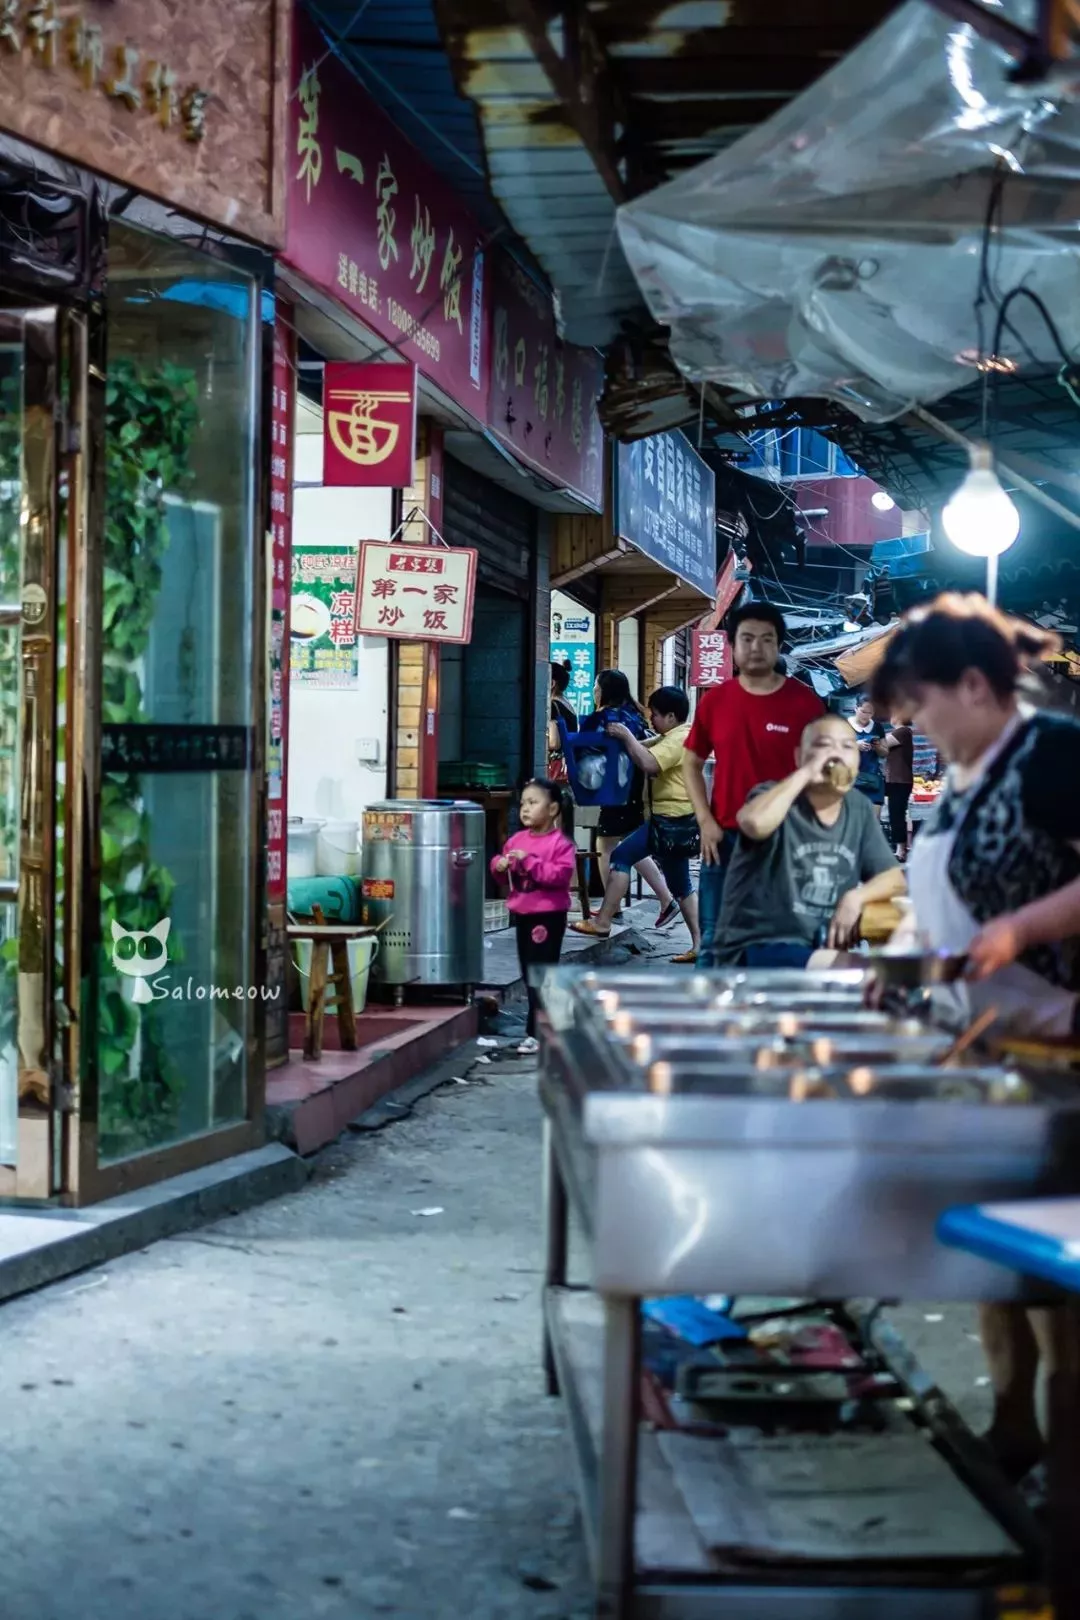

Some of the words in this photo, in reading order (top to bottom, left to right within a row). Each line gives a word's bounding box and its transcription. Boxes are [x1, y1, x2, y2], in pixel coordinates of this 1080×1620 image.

[371, 578, 459, 605] 第一家
[331, 592, 355, 642] 凉糕
[378, 605, 448, 631] 炒饭
